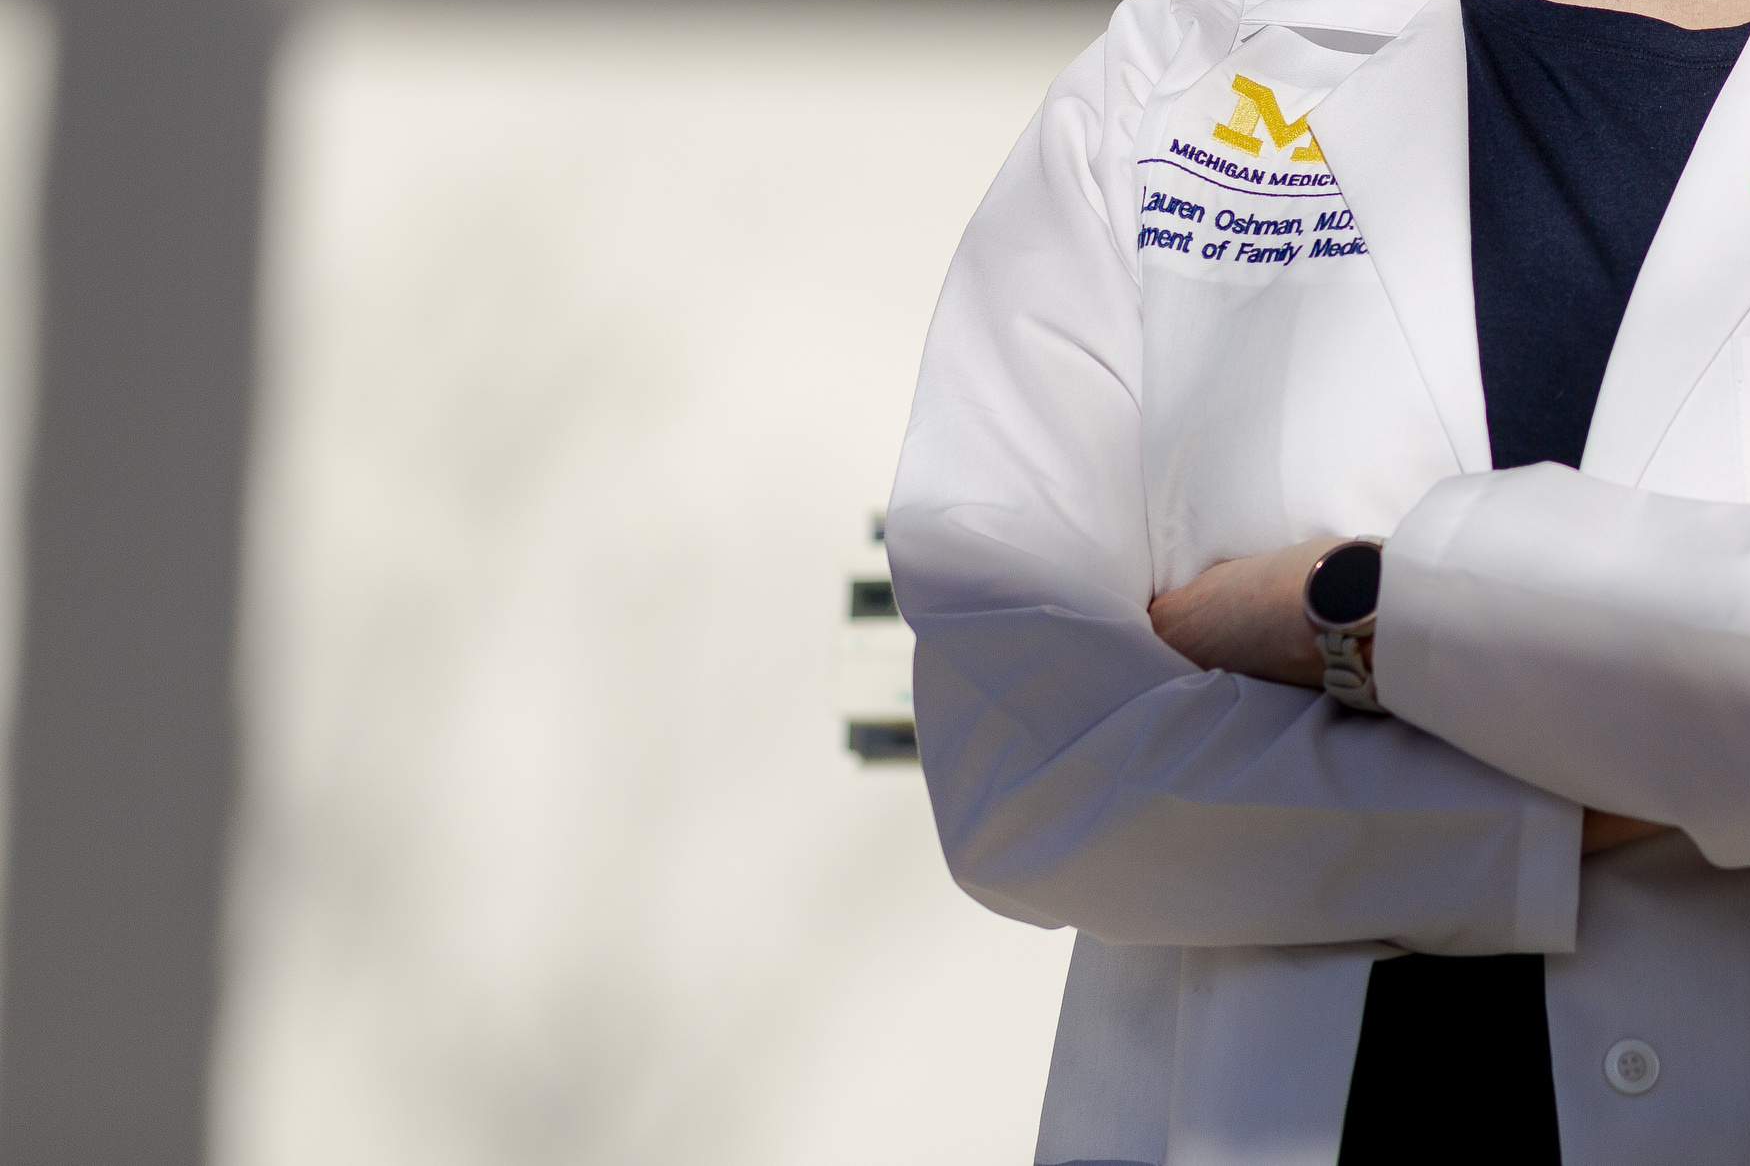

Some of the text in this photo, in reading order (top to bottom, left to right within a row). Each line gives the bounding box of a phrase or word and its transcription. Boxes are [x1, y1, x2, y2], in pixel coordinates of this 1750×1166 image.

[1169, 138, 1339, 187] MICHIGAN MEDICI
[1140, 185, 1206, 223] Lauren
[1215, 209, 1304, 236] Oshman,
[1201, 240, 1231, 261] of
[1234, 241, 1304, 266] Family
